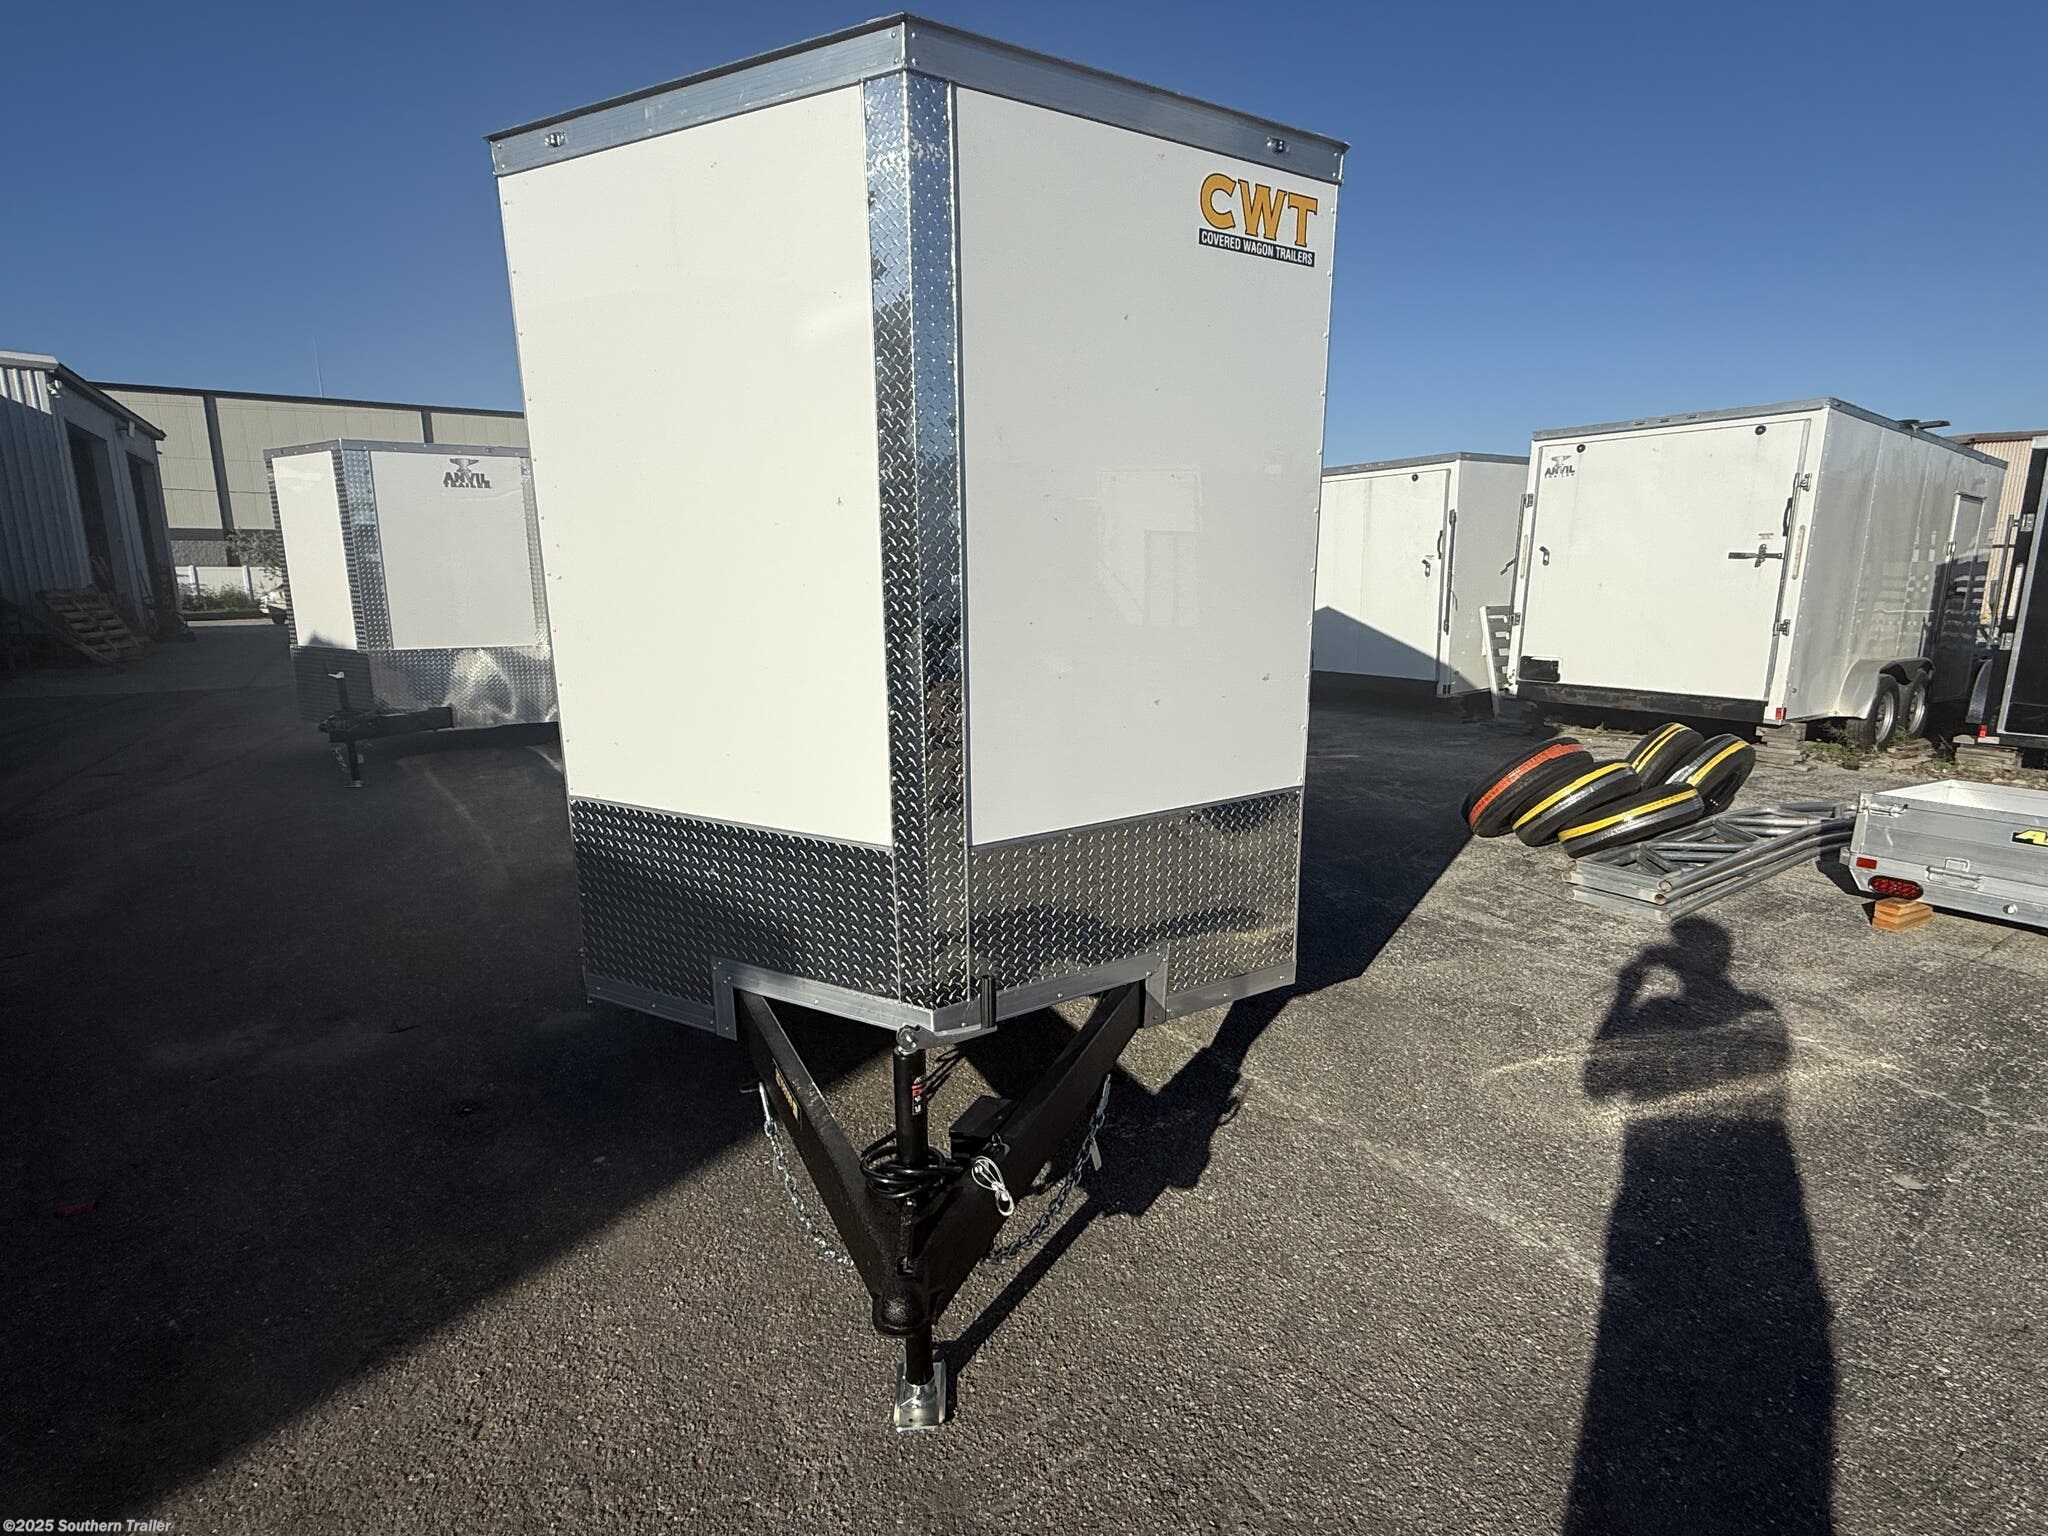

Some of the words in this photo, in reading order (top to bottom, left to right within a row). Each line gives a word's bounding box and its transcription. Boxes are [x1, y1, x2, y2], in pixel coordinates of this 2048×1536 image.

[1200, 173, 1318, 247] CWT
[1201, 230, 1241, 250] COVERED
[1243, 240, 1274, 258] WAGON
[1275, 246, 1313, 265] TRAILERS
[443, 471, 490, 484] ANVIL
[1545, 465, 1575, 476] ANVIL
